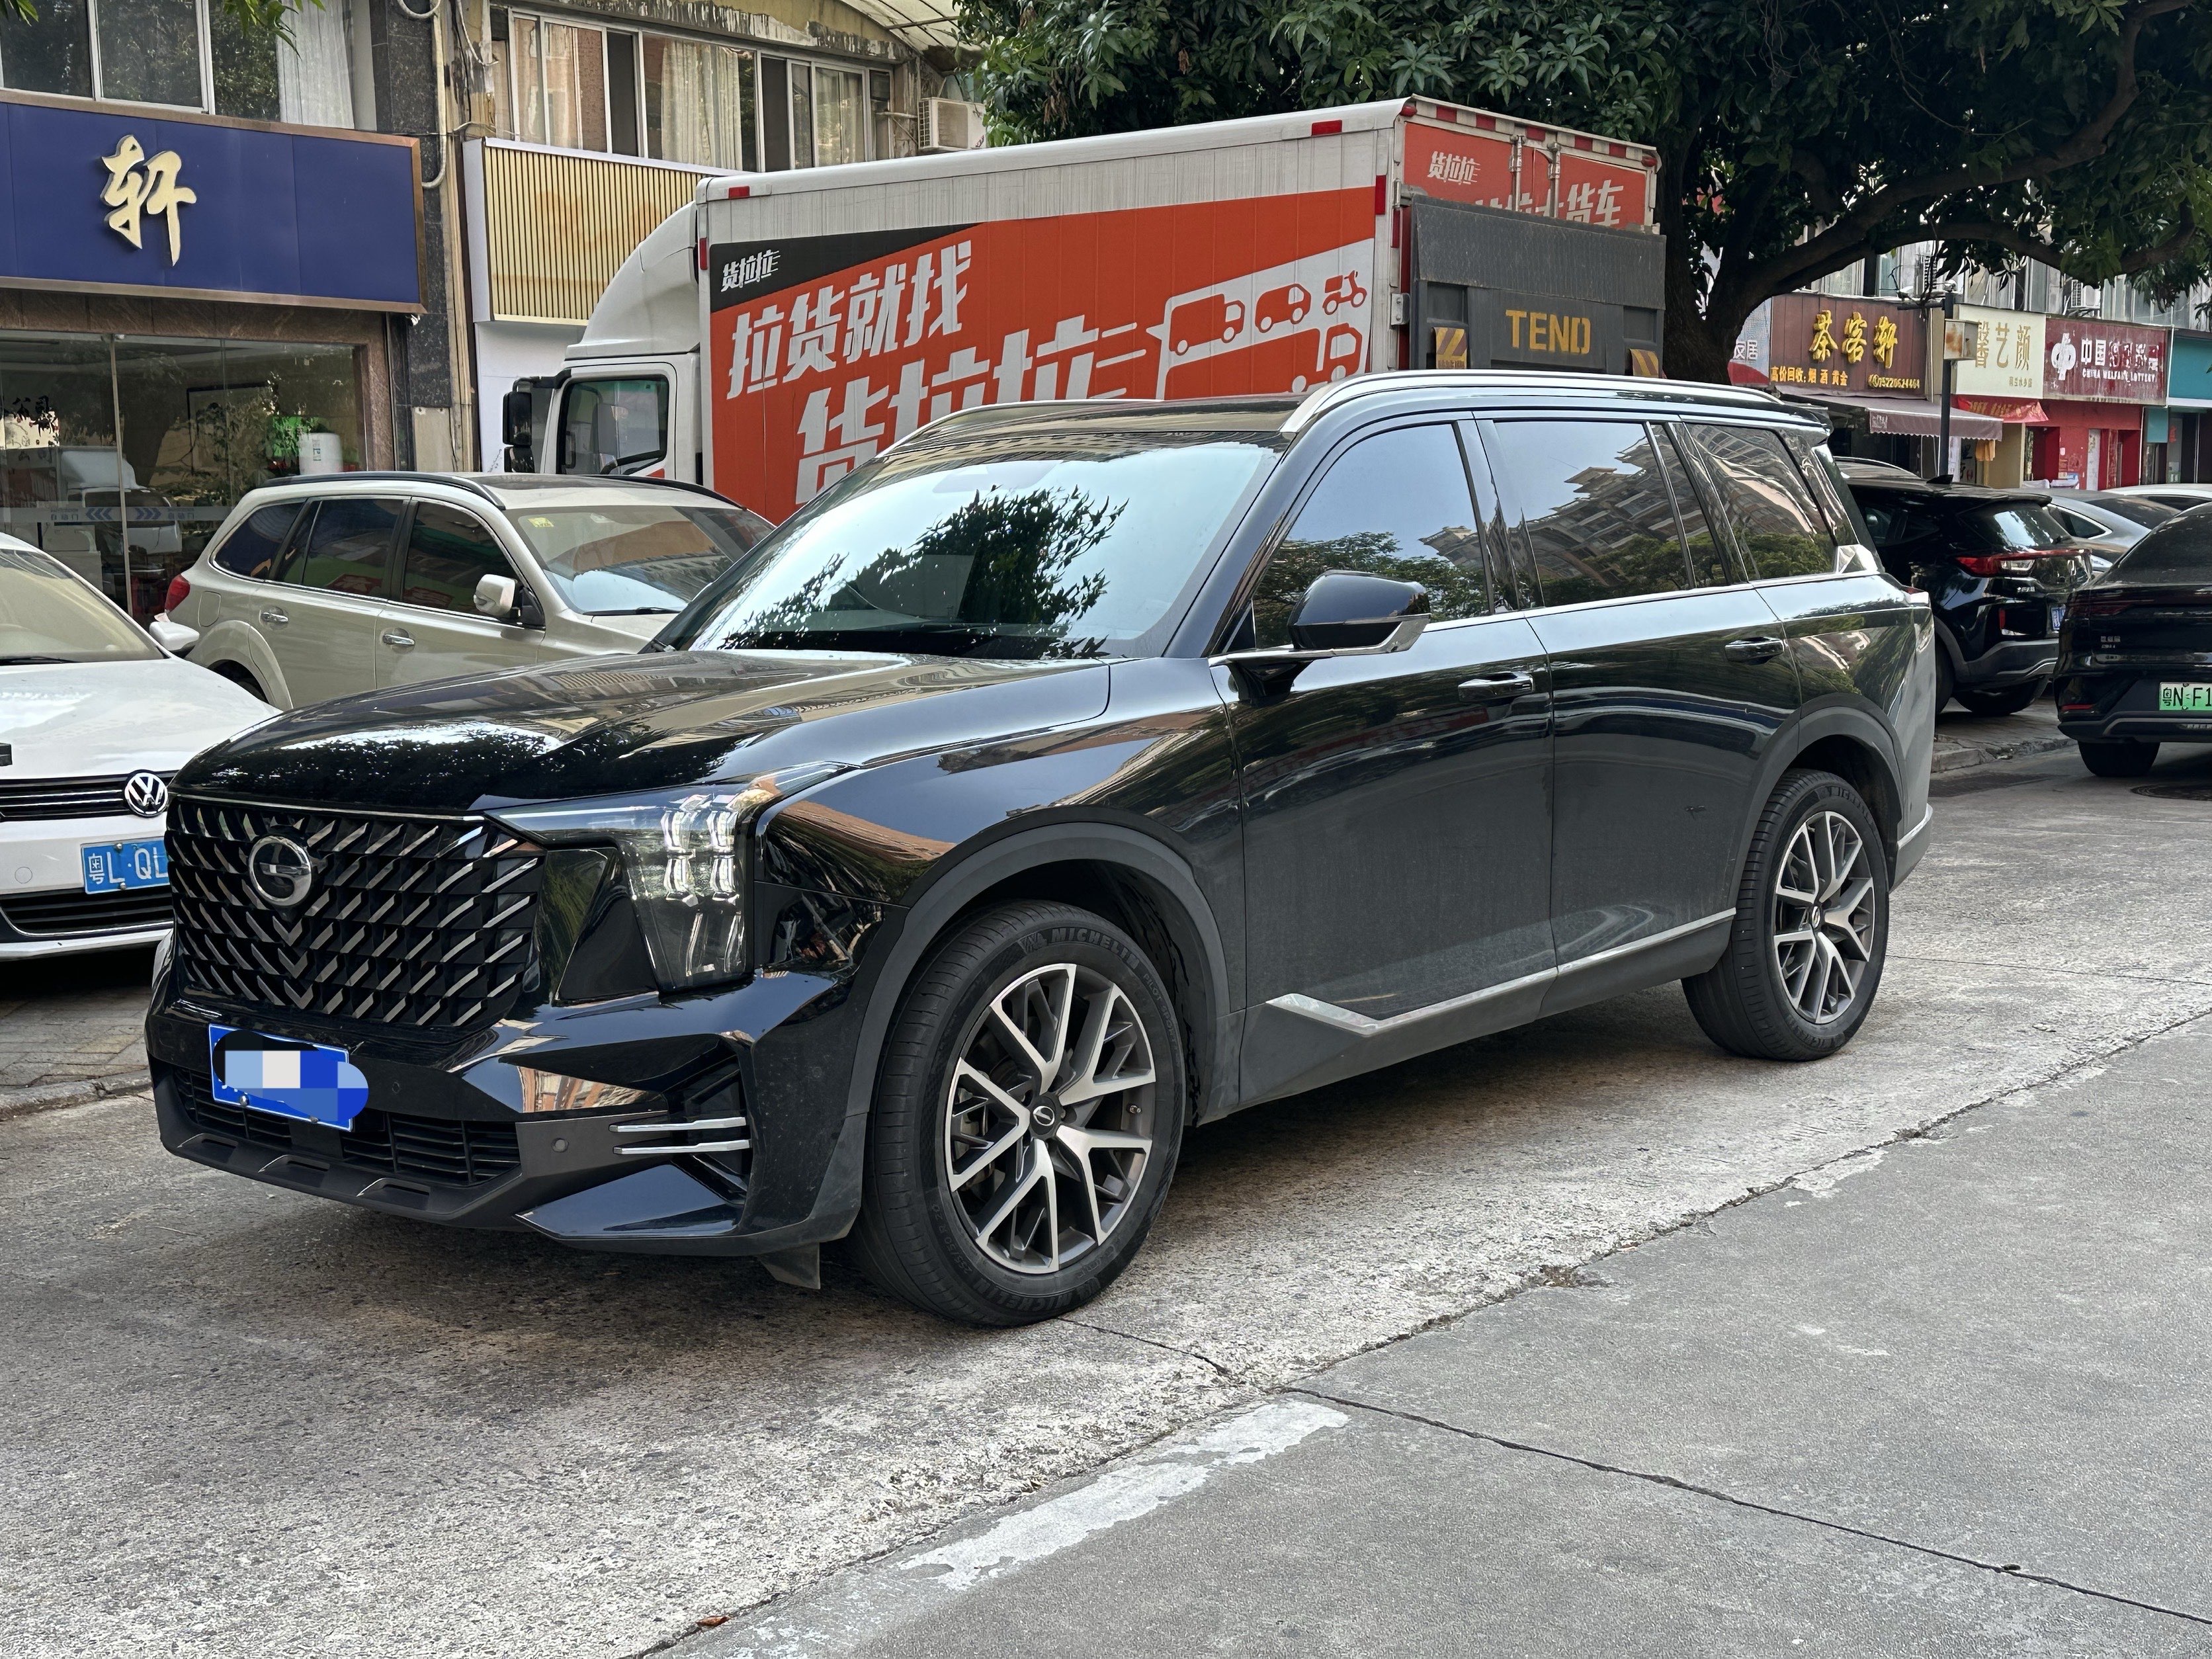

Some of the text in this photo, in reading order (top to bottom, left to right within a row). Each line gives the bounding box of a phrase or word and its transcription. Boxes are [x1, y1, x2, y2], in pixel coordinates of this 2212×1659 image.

[1427, 151, 1481, 185] 货拉拉
[101, 134, 197, 267] 轩
[721, 249, 781, 292] 货拉拉
[727, 240, 972, 400] 拉货就找
[1505, 308, 1592, 355] TEND
[1809, 310, 1898, 369] 茶客轩
[2082, 368, 2101, 378] CHINA
[1052, 928, 1140, 970] MICHELIN
[1142, 974, 1162, 1001] PILOT
